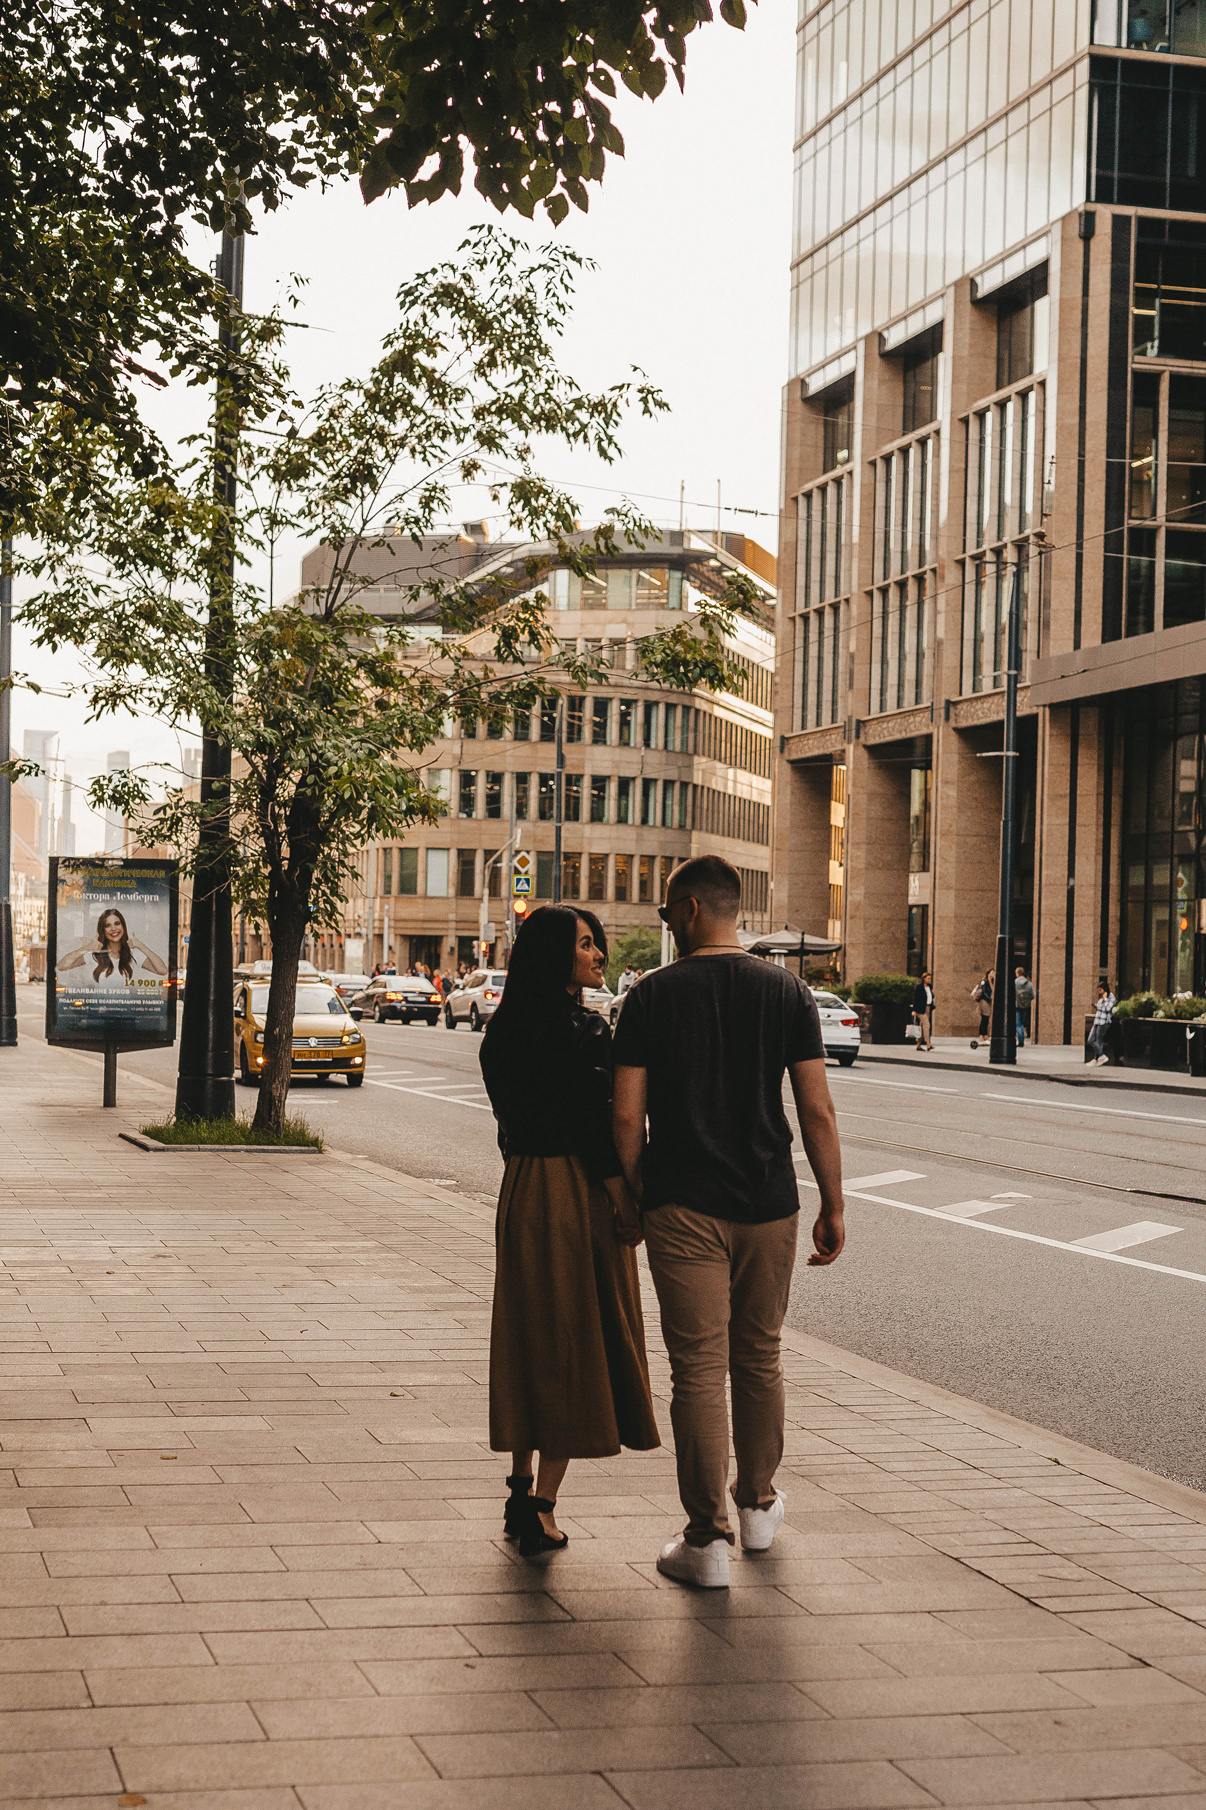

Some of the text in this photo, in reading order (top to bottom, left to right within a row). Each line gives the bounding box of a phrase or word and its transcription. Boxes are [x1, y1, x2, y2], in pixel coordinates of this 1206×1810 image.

[93, 879, 136, 888] КЛИНИКА
[124, 979, 135, 987] 14
[137, 979, 156, 988] 900
[57, 987, 130, 995] ТБЕЛИВАНИЕ ЗУБОВ
